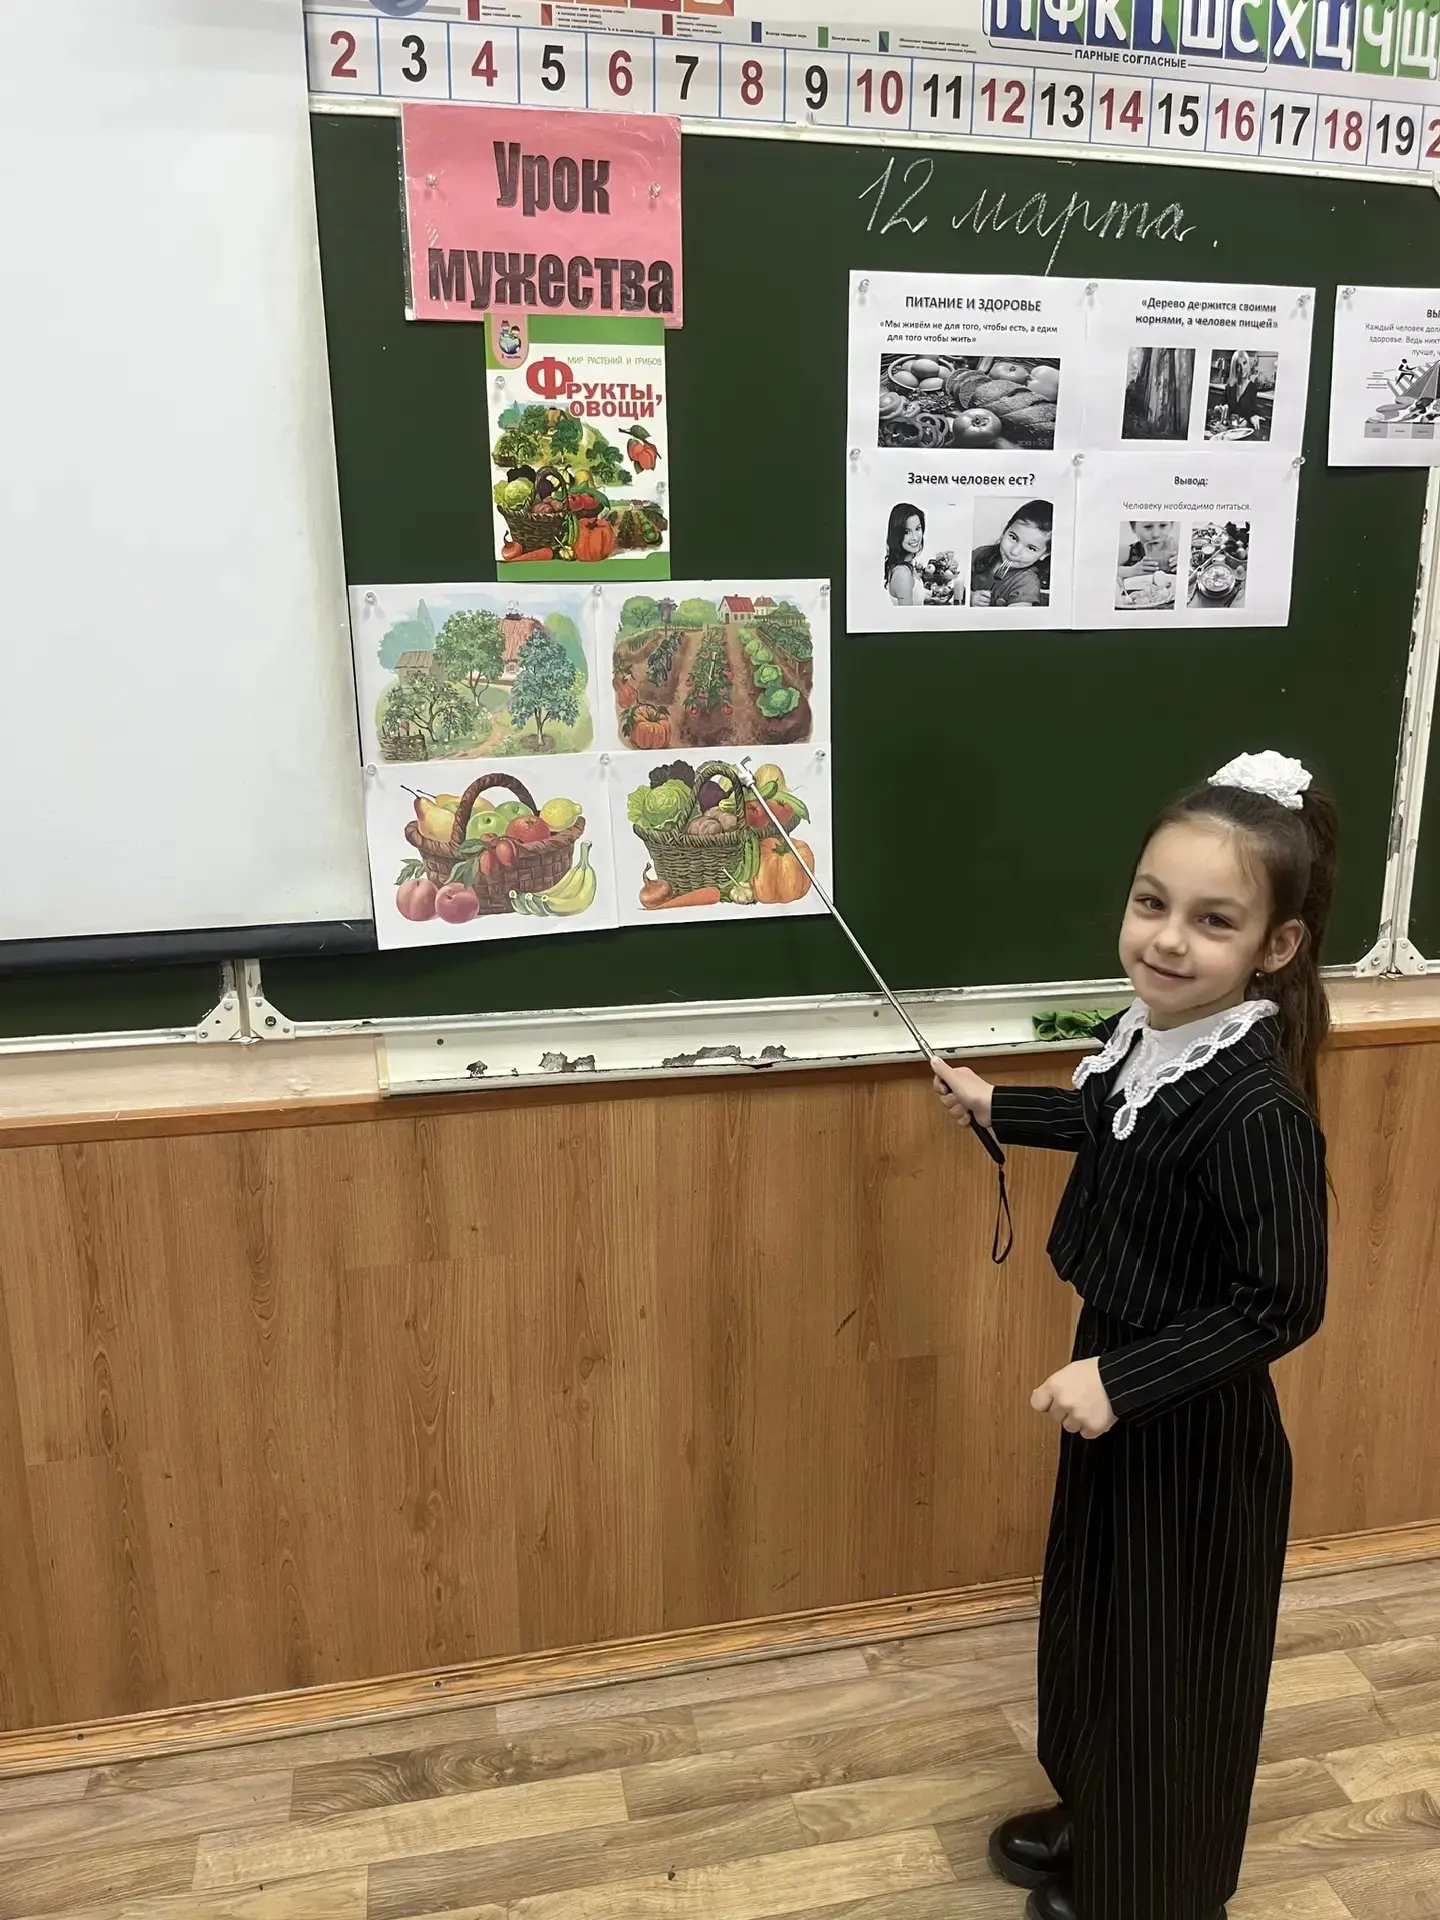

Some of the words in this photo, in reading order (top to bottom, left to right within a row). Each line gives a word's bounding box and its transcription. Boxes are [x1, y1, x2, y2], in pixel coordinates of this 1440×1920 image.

[1182, 0, 1222, 50] Ш
[1230, 0, 1260, 54] С
[1273, 0, 1309, 60] Х
[1315, 0, 1352, 71] Ц
[1362, 5, 1395, 68] Ч
[1400, 8, 1440, 80] Щ
[1074, 49, 1120, 63] ПАРНЫЕ
[1122, 51, 1187, 69] СОГЛАСНЫЕ
[330, 30, 358, 79] 2
[401, 34, 427, 82] 3
[471, 40, 498, 87] 4
[541, 45, 566, 92] 5
[608, 50, 633, 96] 6
[675, 55, 699, 100] 7
[740, 60, 764, 106] 8
[805, 65, 828, 110] 9
[856, 68, 903, 115] 10
[923, 73, 962, 119] 11
[980, 78, 1026, 124] 12
[1040, 82, 1084, 128] 13
[1099, 88, 1144, 133] 14
[1157, 93, 1200, 137] 15
[1214, 98, 1255, 142] 16
[1270, 103, 1310, 147] 17
[1324, 109, 1362, 152] 18
[1375, 113, 1415, 156] 19
[493, 141, 611, 217] Урок
[858, 157, 934, 234] 12
[427, 248, 674, 313] мужества
[905, 296, 963, 310] ПИТАНИЕ
[966, 298, 975, 310] И
[978, 299, 1041, 312] ЗДОРОВЬЕ
[1141, 297, 1186, 310] «Дерево
[1187, 300, 1237, 313] держится
[1239, 303, 1276, 313] своими
[880, 320, 900, 328] «Мы
[902, 321, 931, 330] живём
[944, 324, 960, 332] для
[982, 323, 1007, 332] чтобы
[1135, 315, 1185, 327] корнями,
[1195, 318, 1237, 327] человек
[1239, 319, 1278, 330] пищей»
[1365, 323, 1394, 332] Каждый
[1395, 325, 1425, 333] человек
[887, 333, 904, 342] для
[924, 334, 949, 343] чтобы
[1405, 336, 1423, 345] Ведь
[567, 356, 584, 364] МИР
[587, 357, 623, 366] РАСТЕНИЙ
[634, 358, 662, 366] ГРИБОВ
[569, 401, 655, 421] ОВОЩИ
[907, 472, 948, 484] Зачем
[951, 475, 1005, 485] человек
[1008, 473, 1035, 486] ест?
[1174, 476, 1208, 487] Вывод:
[1123, 501, 1162, 511] Человеку
[1163, 502, 1214, 511] необходимо
[1216, 503, 1252, 511] питаться.
